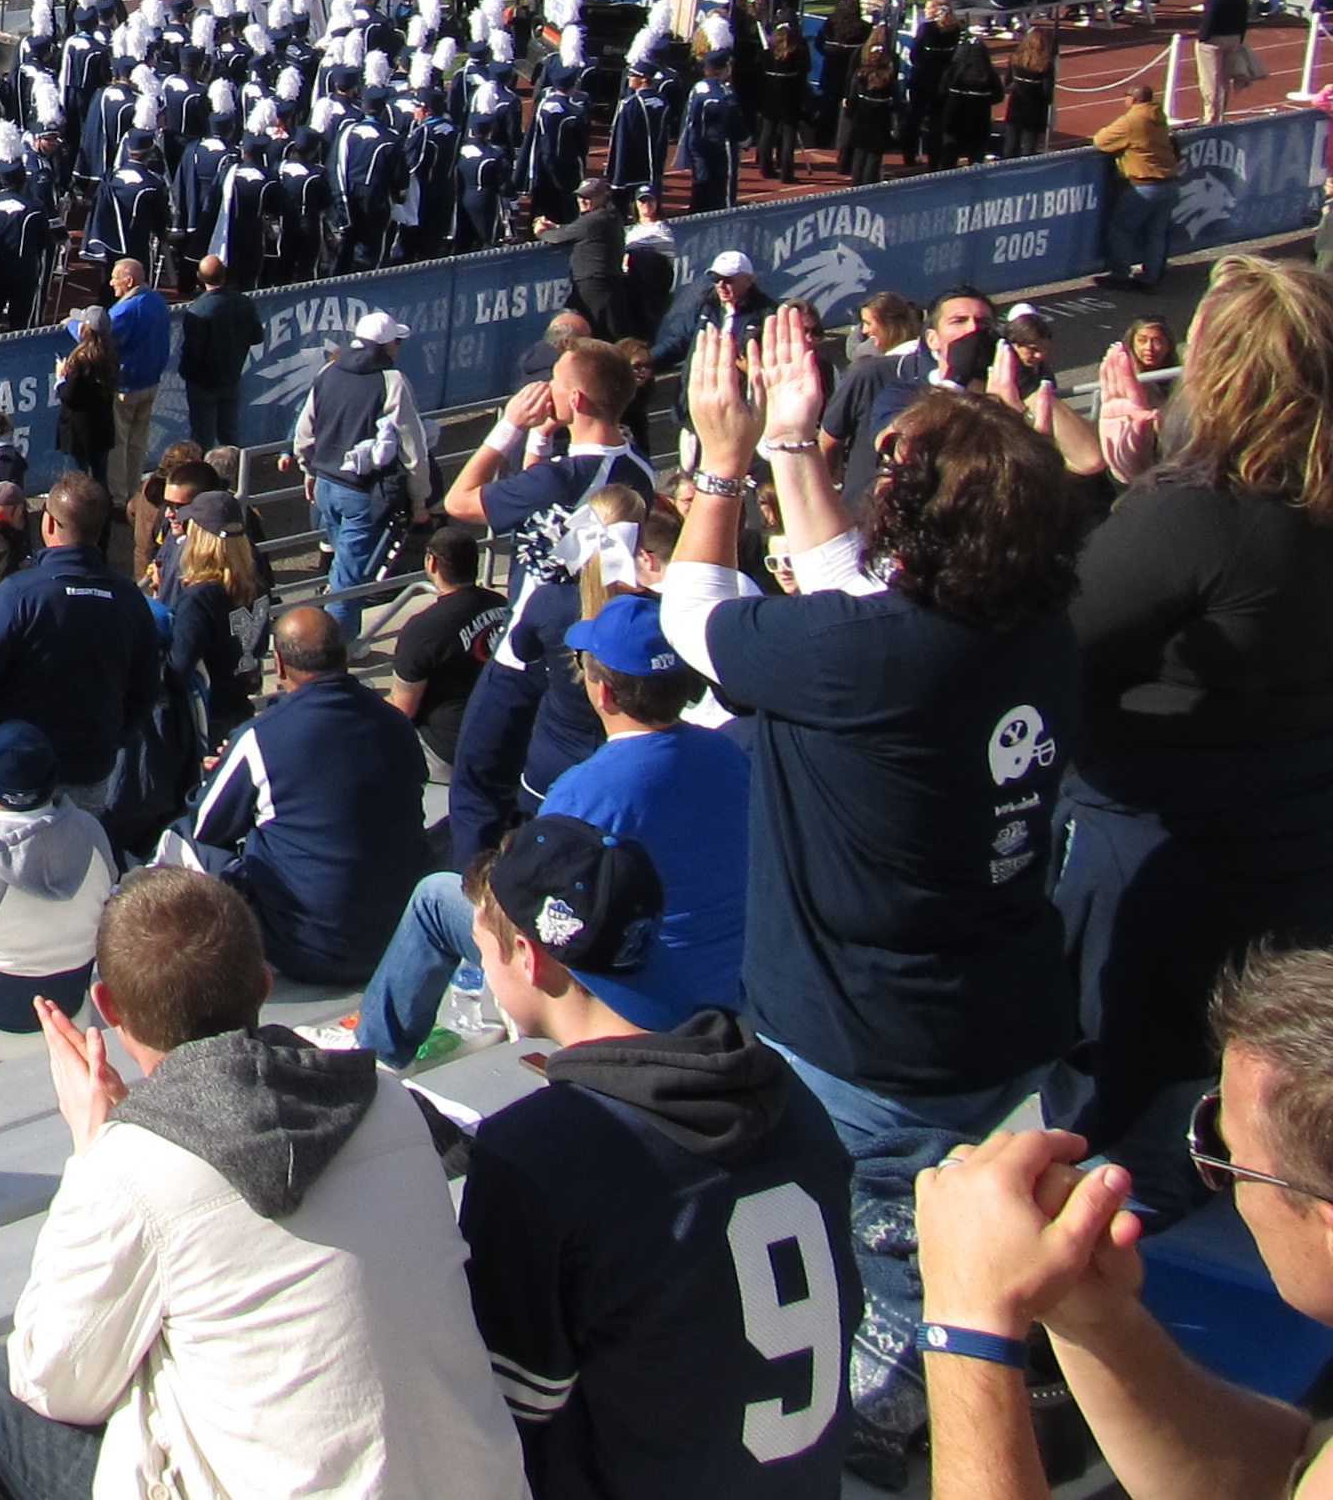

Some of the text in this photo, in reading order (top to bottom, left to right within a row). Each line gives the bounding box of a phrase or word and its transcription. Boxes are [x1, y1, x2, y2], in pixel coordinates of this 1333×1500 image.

[1042, 184, 1098, 221] BOWL
[772, 204, 888, 272] NEVADA
[992, 228, 1050, 265] 2005
[474, 286, 527, 326] LAS
[650, 652, 675, 670] BYU
[726, 1181, 840, 1464] 9
